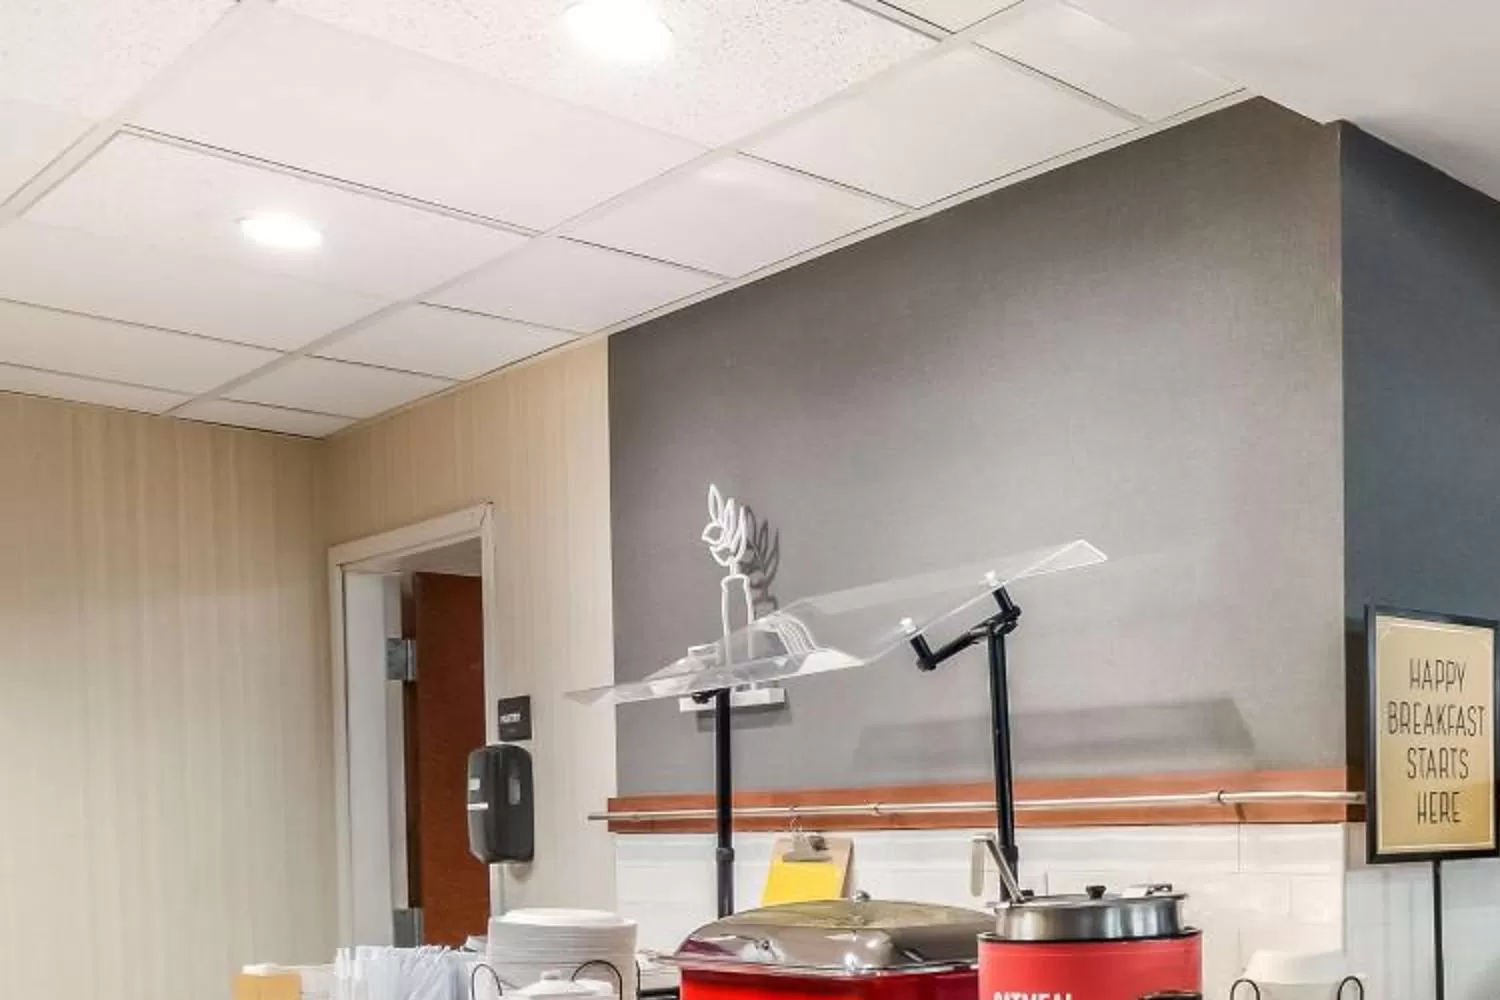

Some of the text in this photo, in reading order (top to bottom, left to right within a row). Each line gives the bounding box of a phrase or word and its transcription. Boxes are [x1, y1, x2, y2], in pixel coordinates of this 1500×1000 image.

[1408, 658, 1466, 693] HAPPY
[1387, 701, 1485, 736] BREAKFAST
[1407, 748, 1469, 779] STARTS
[1417, 792, 1462, 824] HERE
